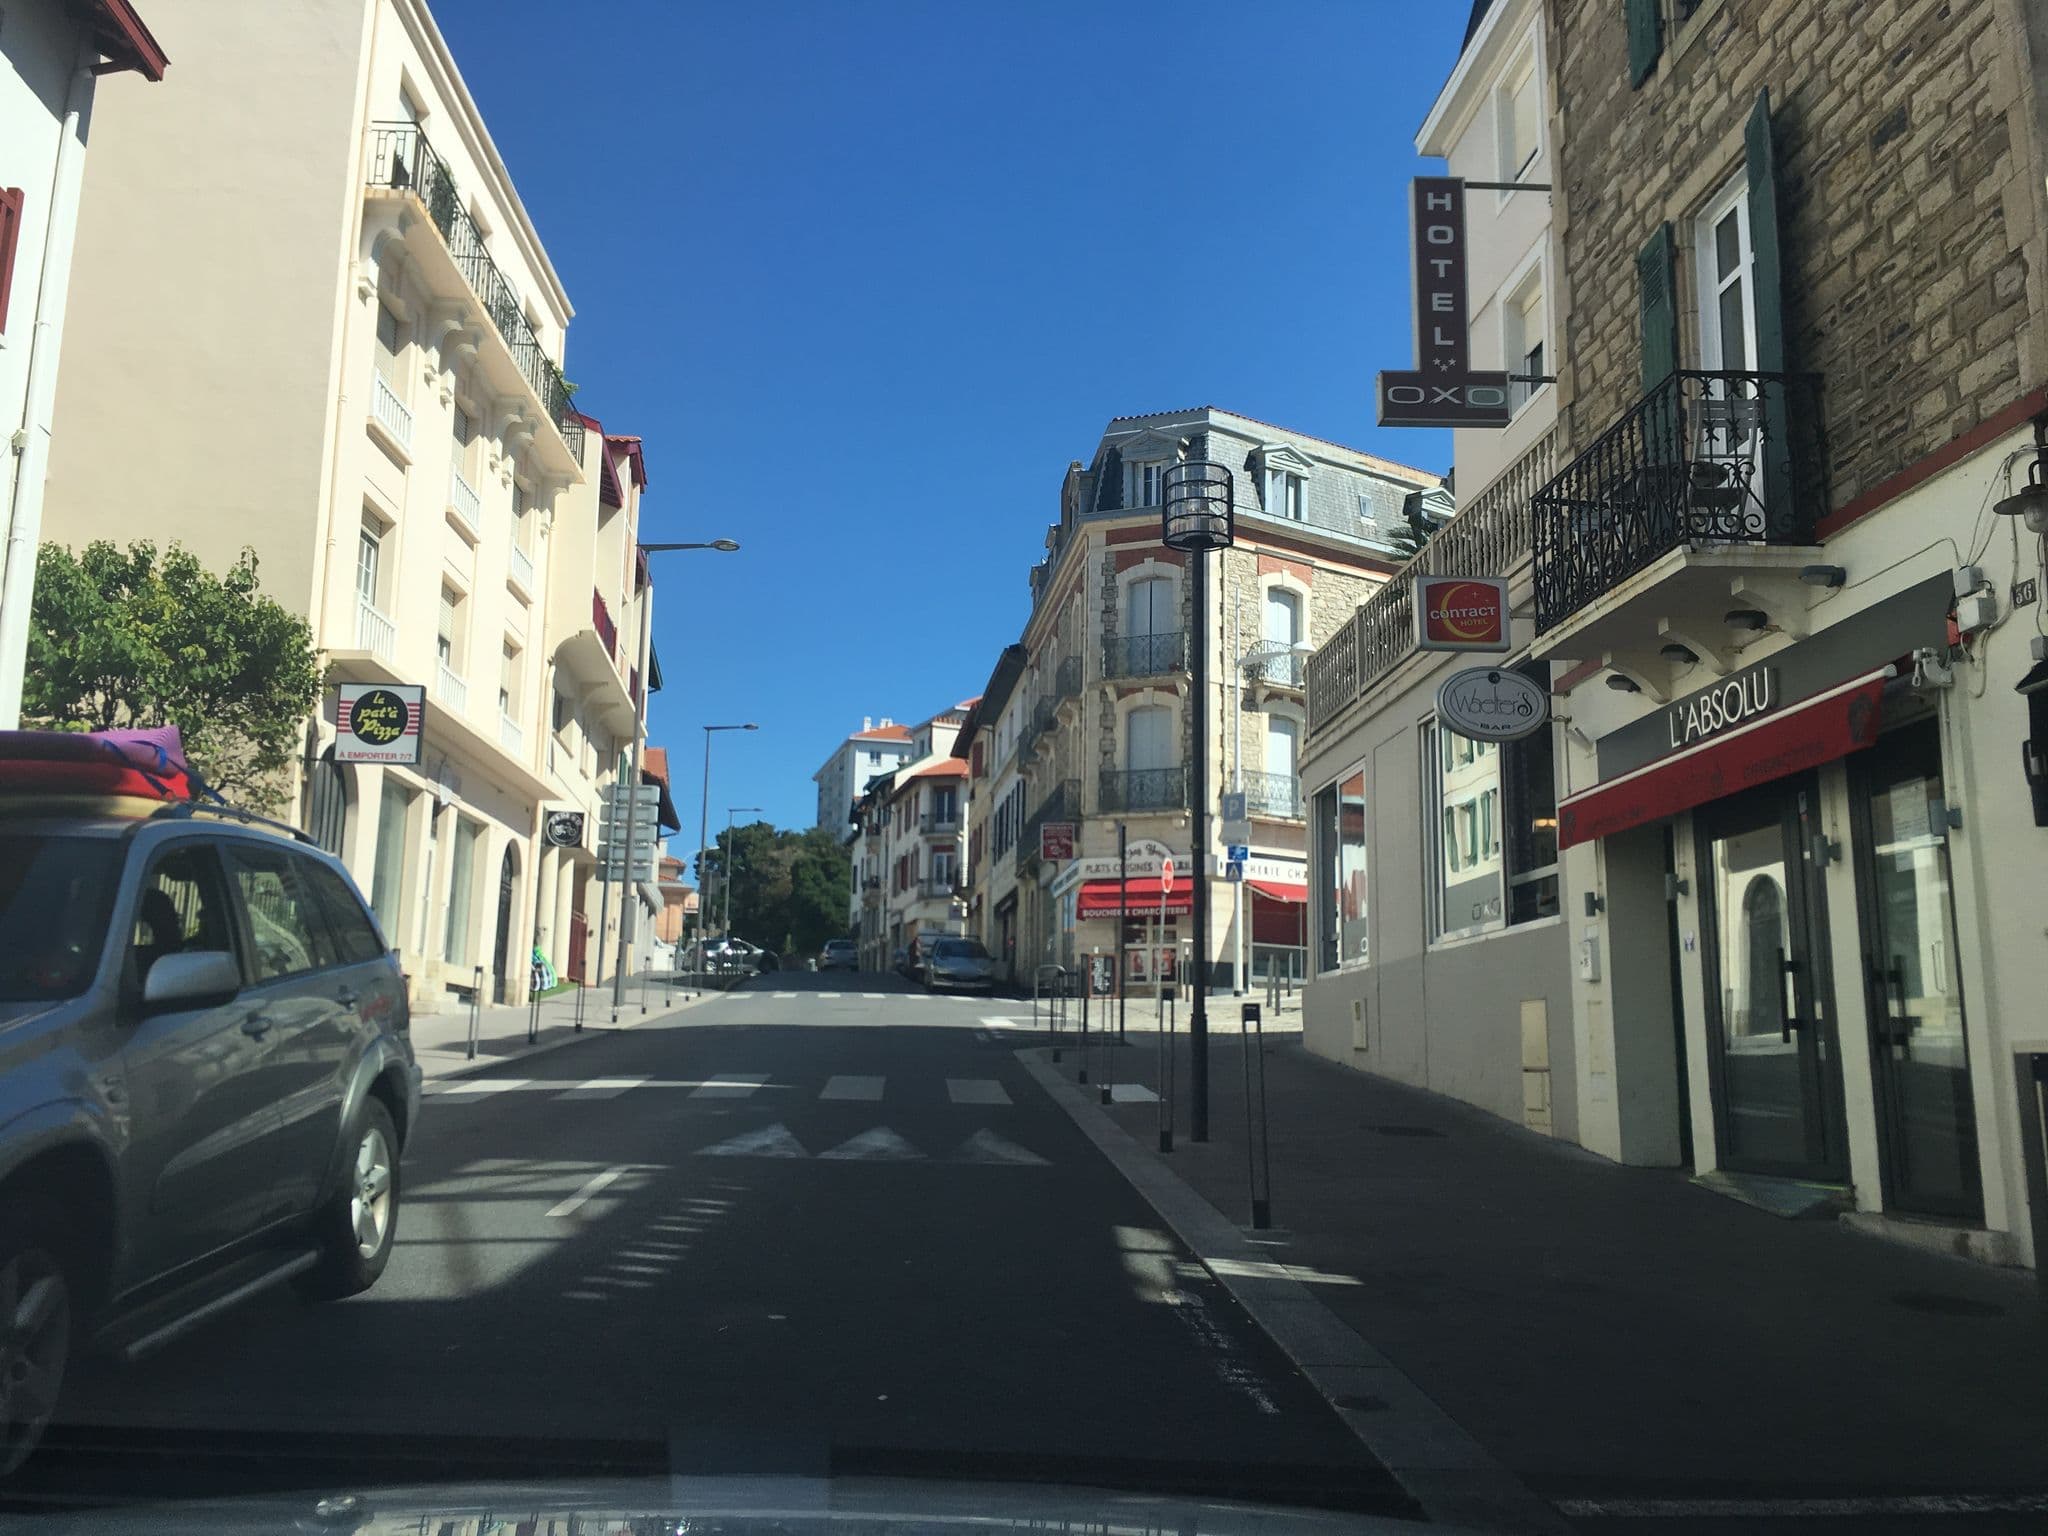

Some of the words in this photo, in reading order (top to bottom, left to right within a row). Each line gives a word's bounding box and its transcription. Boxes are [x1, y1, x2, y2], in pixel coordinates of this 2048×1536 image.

[1426, 192, 1455, 346] HOTEL
[1386, 385, 1505, 406] OXO
[1668, 666, 1770, 748] L'ABSOLU
[358, 719, 401, 741] Pizza
[1480, 722, 1512, 731] BAR
[347, 752, 398, 760] EMPORTER
[1229, 799, 1239, 816] P
